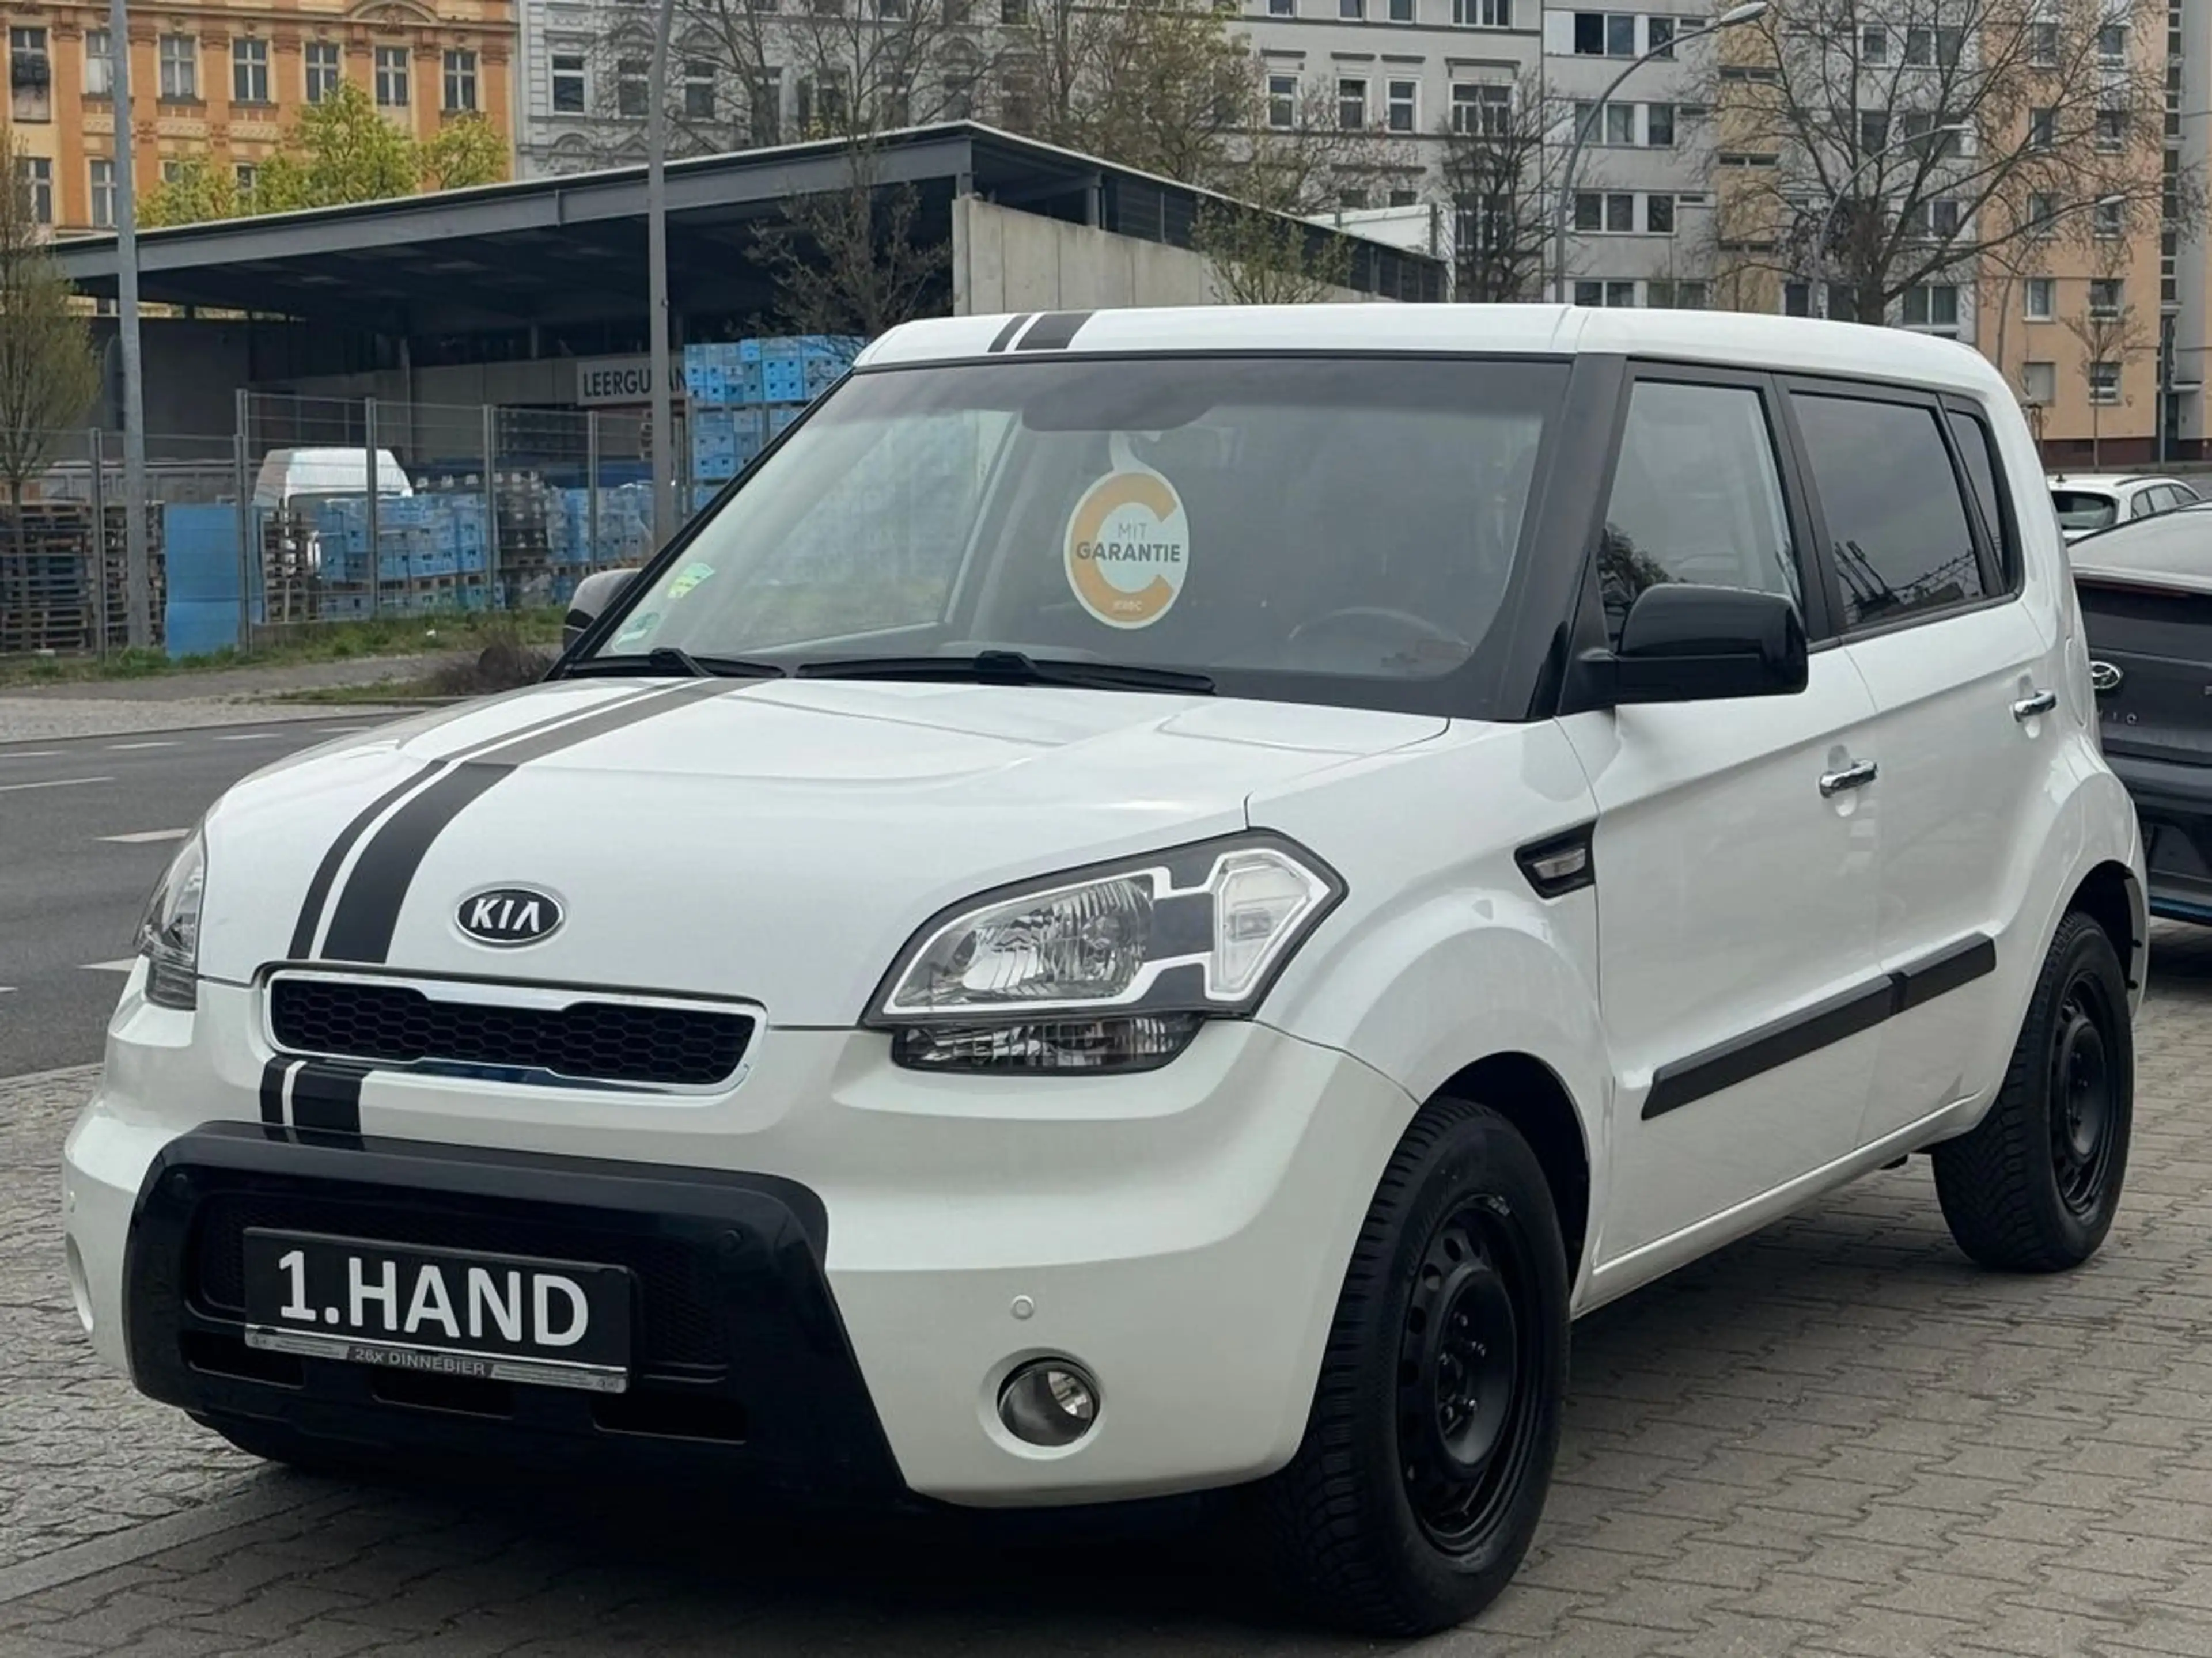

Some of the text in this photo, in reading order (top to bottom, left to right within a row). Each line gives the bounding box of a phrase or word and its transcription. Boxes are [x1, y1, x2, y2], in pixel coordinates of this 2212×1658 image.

[1118, 522, 1147, 541] MIT
[1075, 541, 1181, 563] GARANTIE
[469, 898, 540, 933] KIA
[278, 1250, 589, 1346] 1.HAND
[388, 1352, 485, 1375] DINNEBIER
